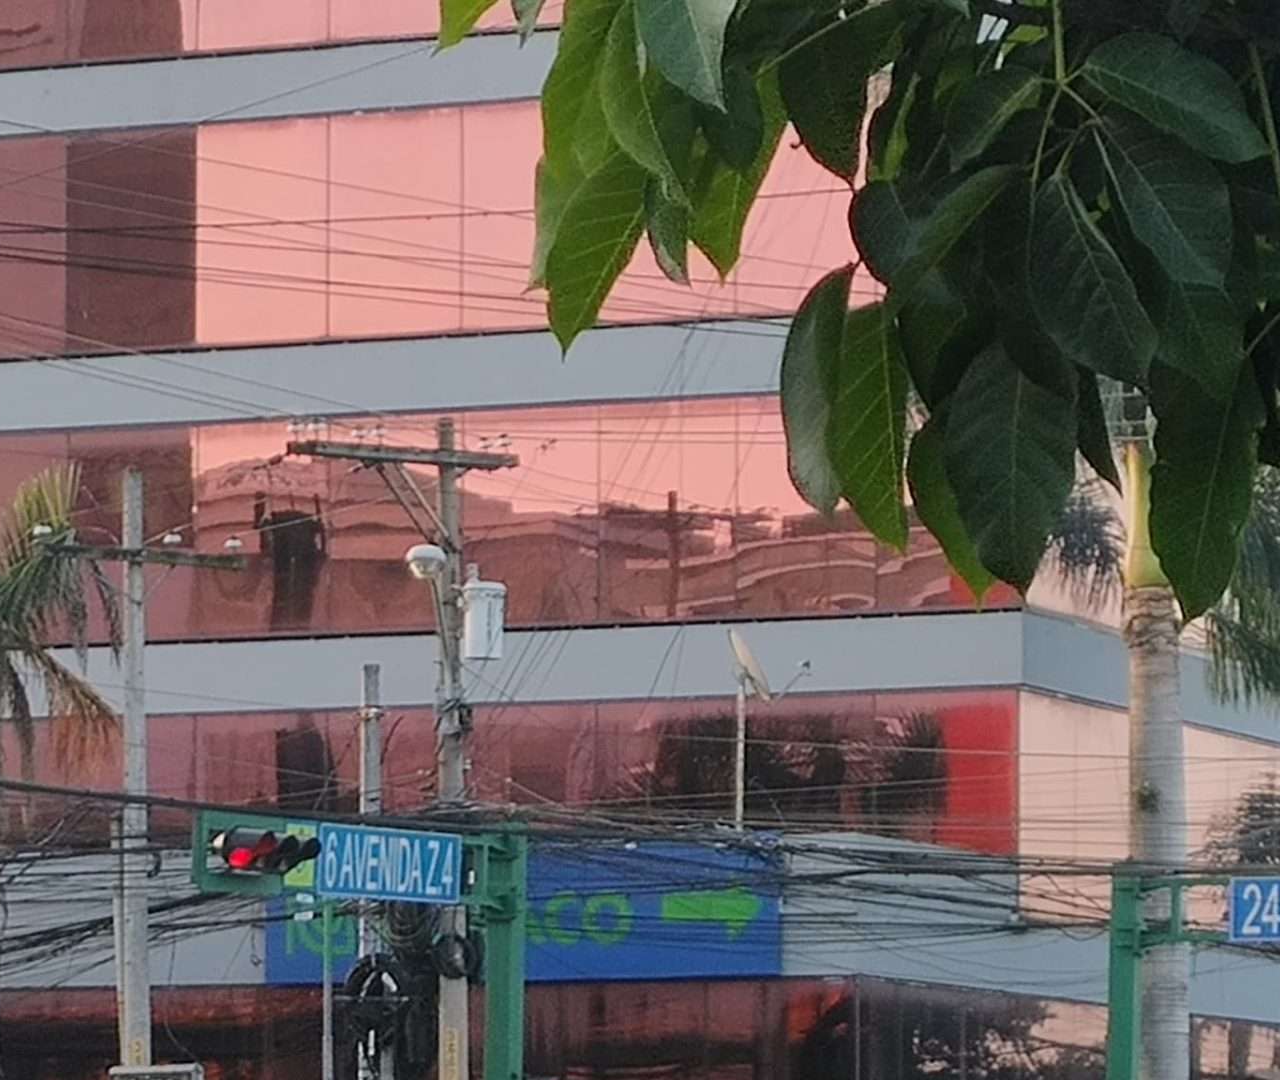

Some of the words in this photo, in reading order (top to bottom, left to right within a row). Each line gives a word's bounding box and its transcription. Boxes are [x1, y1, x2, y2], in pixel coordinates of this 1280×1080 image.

[325, 831, 338, 888] 6
[340, 832, 423, 894] AVENIDA
[1241, 883, 1280, 934] 24
